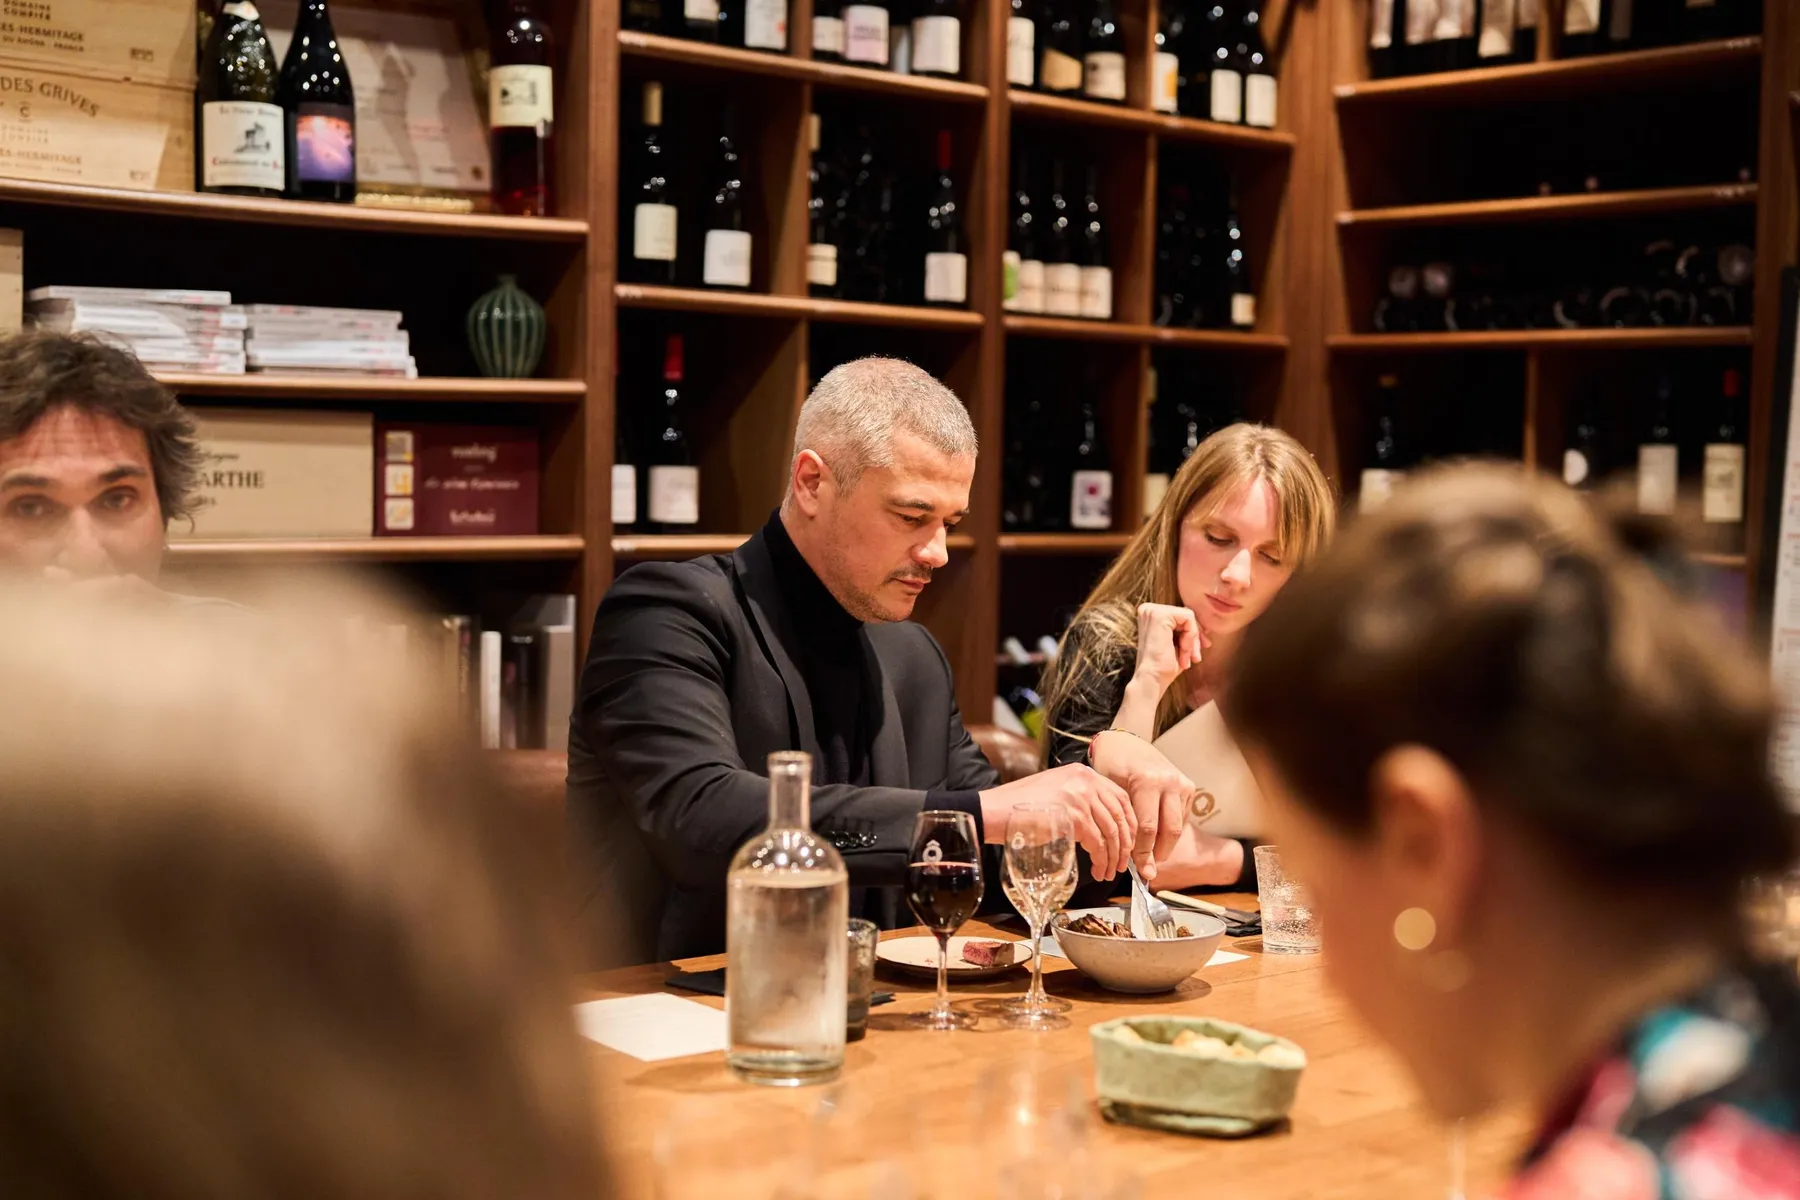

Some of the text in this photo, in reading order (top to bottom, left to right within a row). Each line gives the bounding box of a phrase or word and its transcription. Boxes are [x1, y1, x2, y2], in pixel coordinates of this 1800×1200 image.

[19, 25, 84, 41] HERMITAGE
[0, 76, 100, 118] DES GRIVES
[17, 149, 83, 165] HERMITAGE
